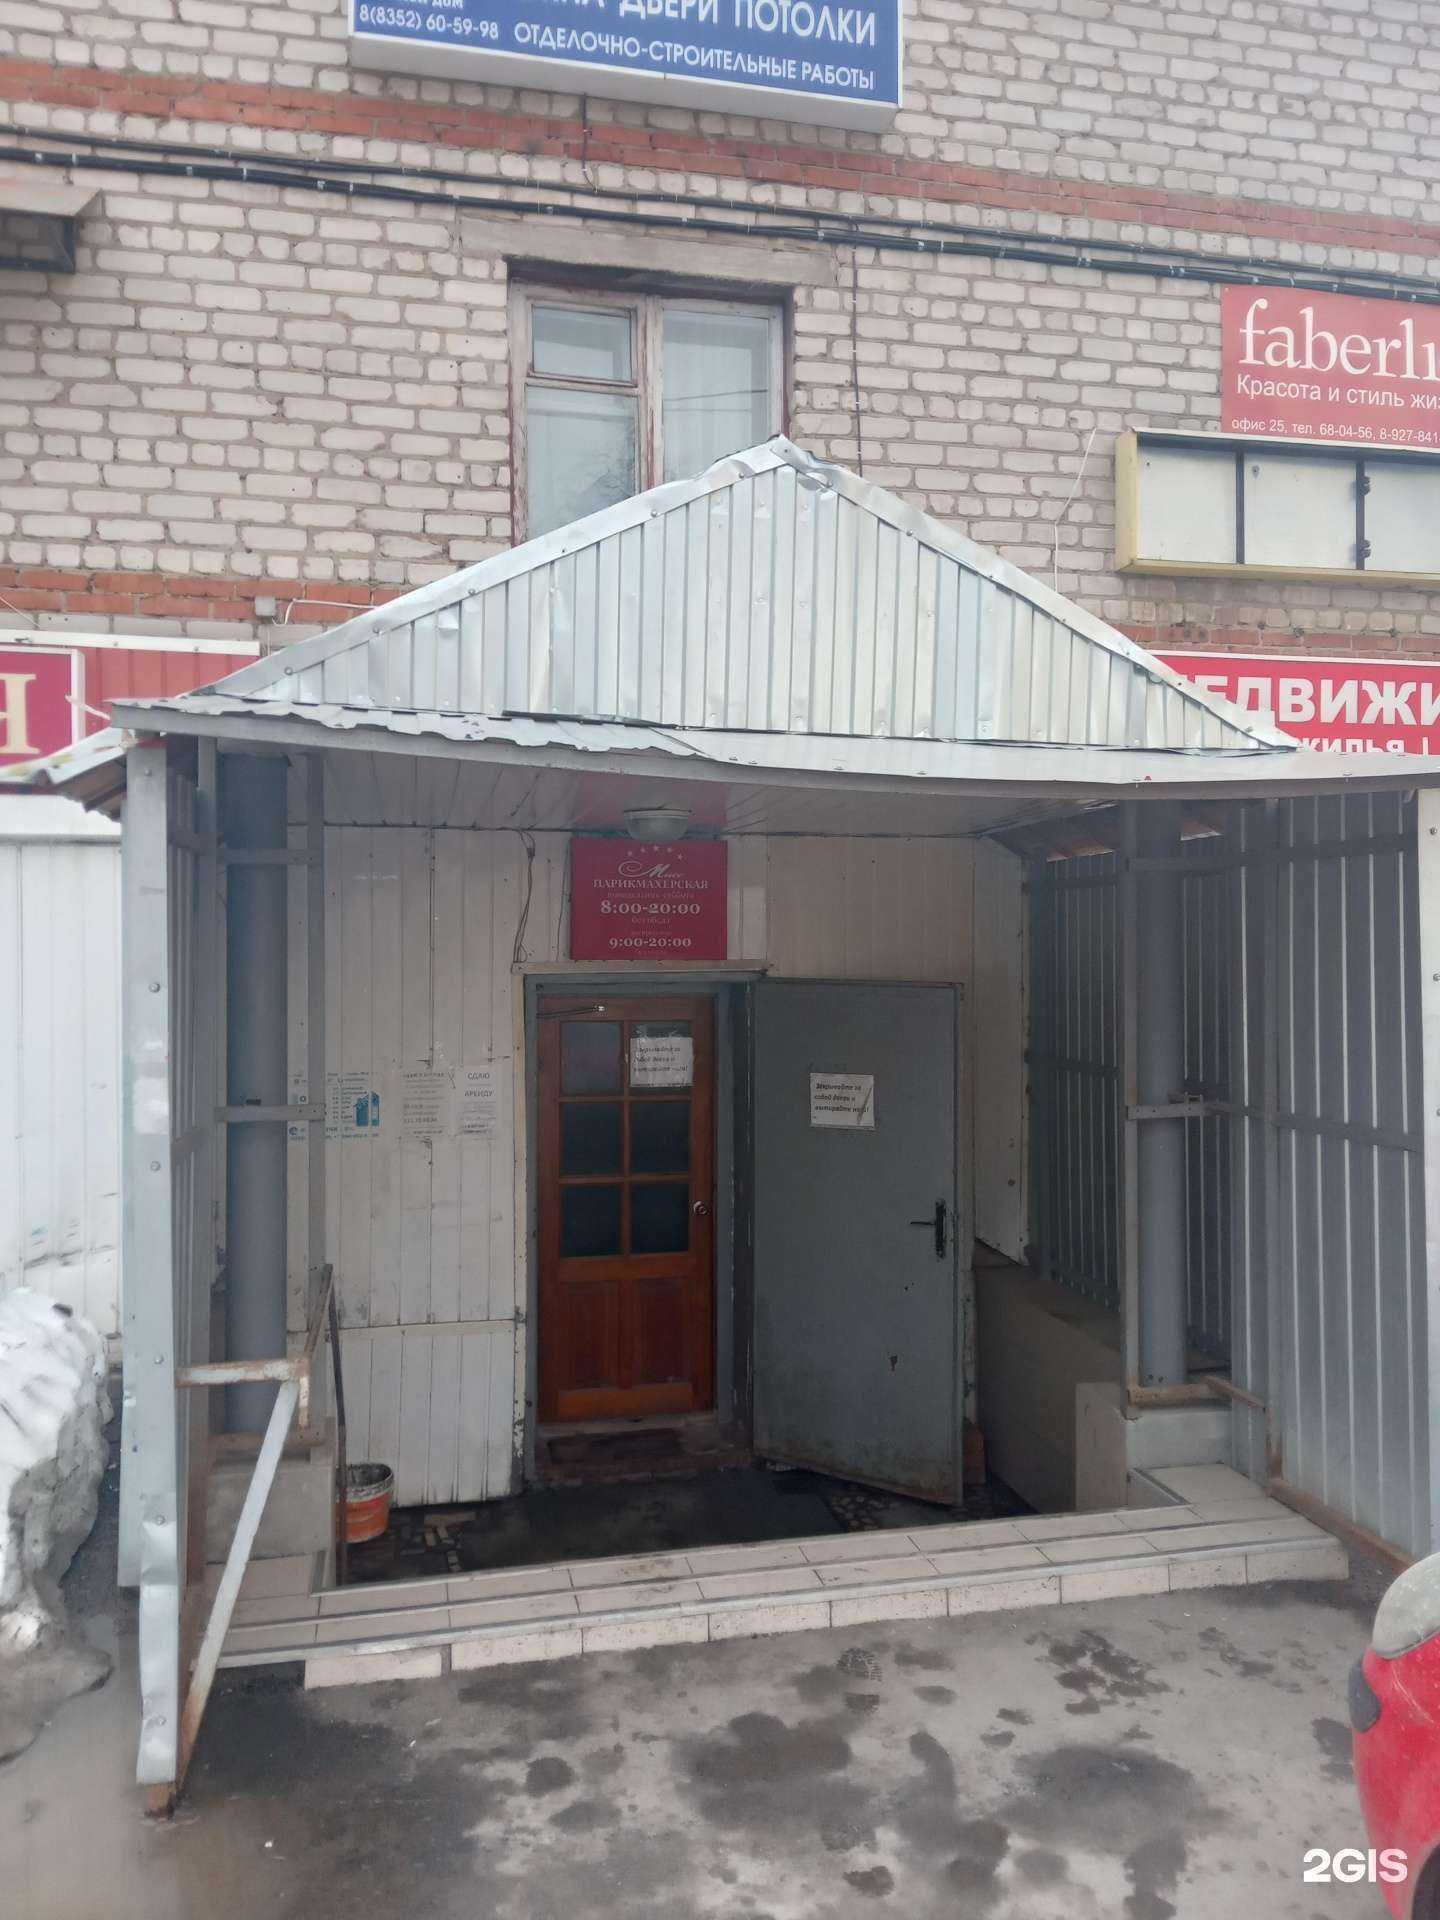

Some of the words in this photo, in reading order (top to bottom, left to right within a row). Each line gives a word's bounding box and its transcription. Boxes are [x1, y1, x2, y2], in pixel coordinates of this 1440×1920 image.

[360, 4, 422, 31] 8(8352)
[426, 13, 499, 40] 60-59-98
[735, 0, 877, 48] ПОТОЛКИ
[514, 22, 797, 80] ОТДЕЛОЧНО-СТРОИТЕЛЬНЫЕ
[801, 61, 874, 91] РАБОТЫ
[1238, 298, 1440, 382] faberli
[1237, 373, 1321, 401] Красота
[1329, 387, 1340, 402] и
[1347, 388, 1405, 408] стиль
[1411, 394, 1440, 411] жи
[1231, 417, 1266, 433] офис
[1269, 419, 1288, 435] 25,
[1291, 423, 1317, 435] тел.
[1319, 423, 1376, 441] 68-04-56,
[1178, 675, 1440, 727] ДВИЖИ
[593, 879, 709, 889] ПАРИКМАХЕРСКАЯ
[600, 900, 701, 914] 8:00-20:00
[609, 937, 692, 950] 9:00-20:00
